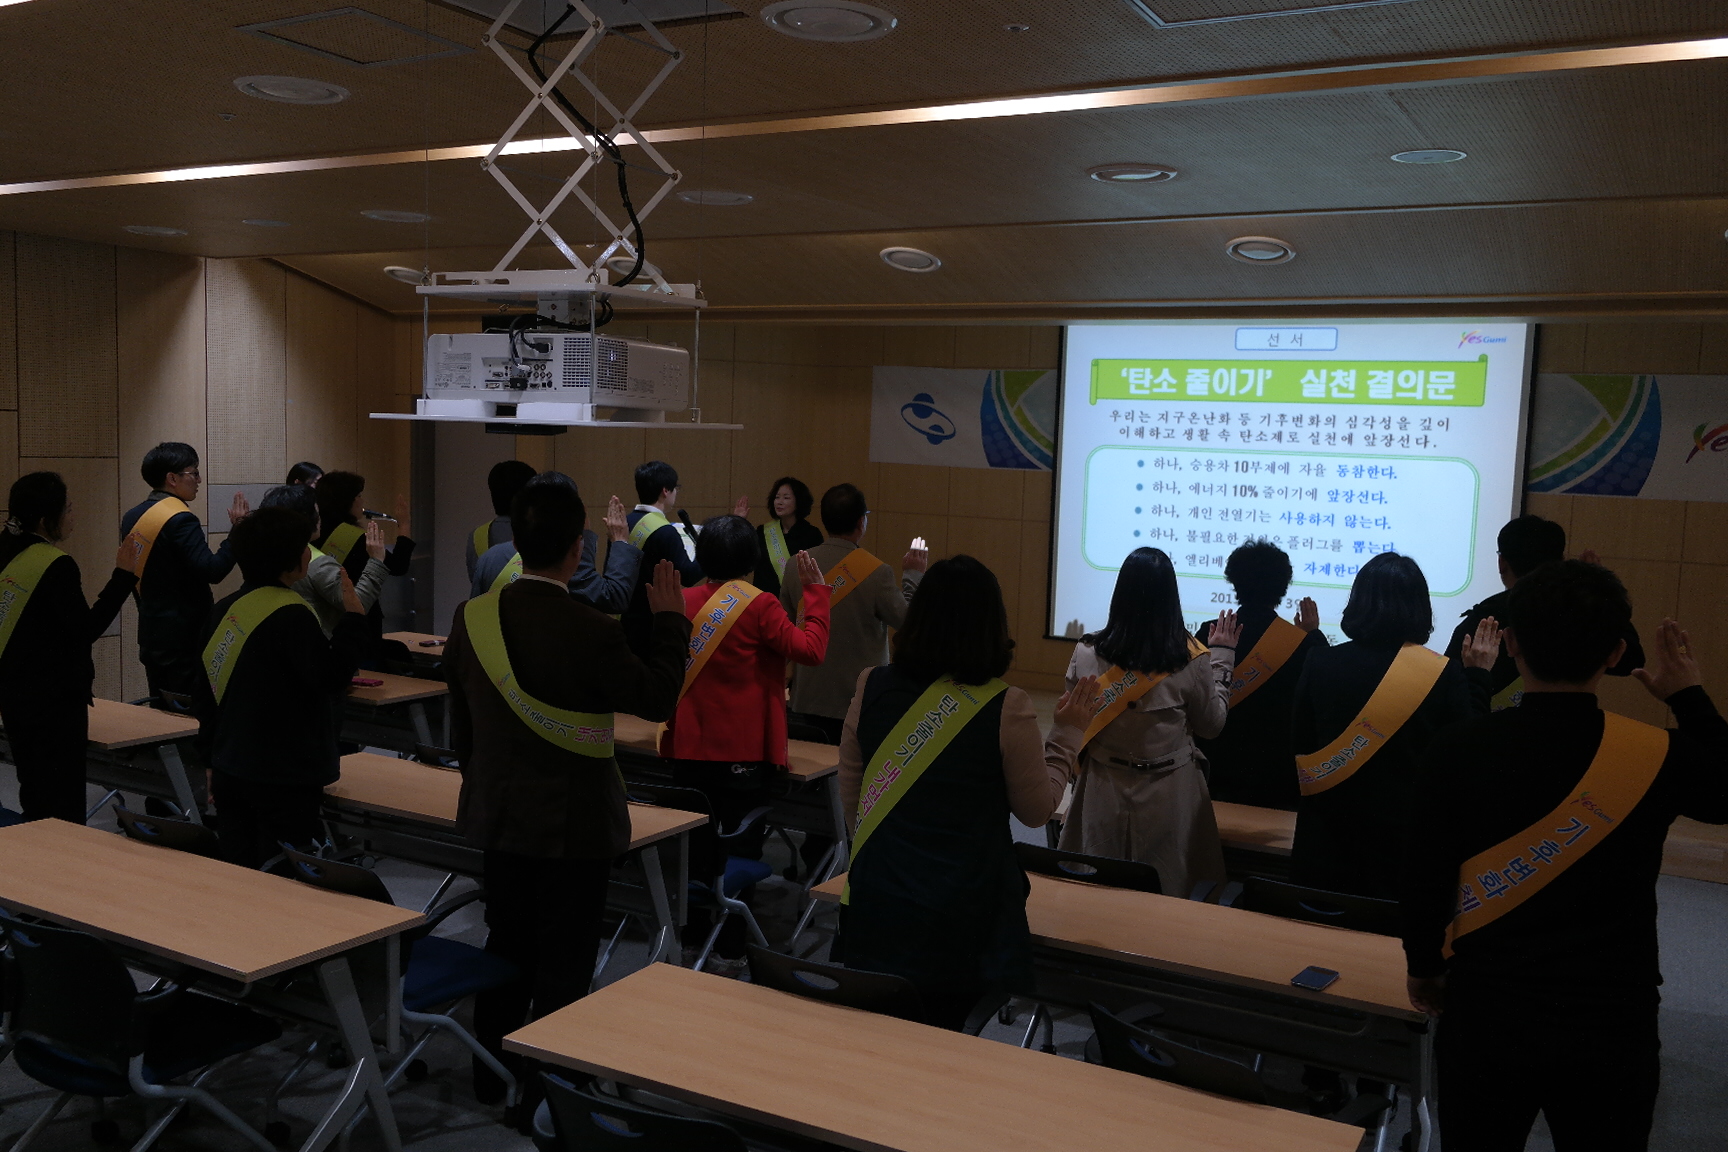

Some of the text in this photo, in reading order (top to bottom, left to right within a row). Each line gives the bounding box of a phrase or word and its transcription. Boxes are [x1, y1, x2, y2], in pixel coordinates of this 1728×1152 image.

[1300, 369, 1356, 398] 실천
[1367, 370, 1456, 400] 결의문
[1109, 409, 1450, 432] 우리는 지구온난화 등 기후변화의 심각성을 깊이
[1119, 426, 1437, 449] 이해하고 생활 속 탄소제로 실천에 앞장선다.
[1154, 457, 1398, 480] 하나, 승용차 10부제에 자율 동참한다.
[1152, 481, 1388, 504] 하나, 에너지 10% 줄이기에 앞장선다.
[1151, 504, 1391, 530] 하나, 개인 전열기는 사용하지 않는다.
[1150, 527, 1178, 541] 하나,
[1187, 529, 1238, 545] 불필요한
[1287, 535, 1343, 553] 플러그를
[1185, 553, 1228, 568] 엘리베
[689, 594, 739, 655] 기후변화
[895, 694, 960, 767] 탄소줄이기
[1476, 817, 1591, 900] 기후변화
